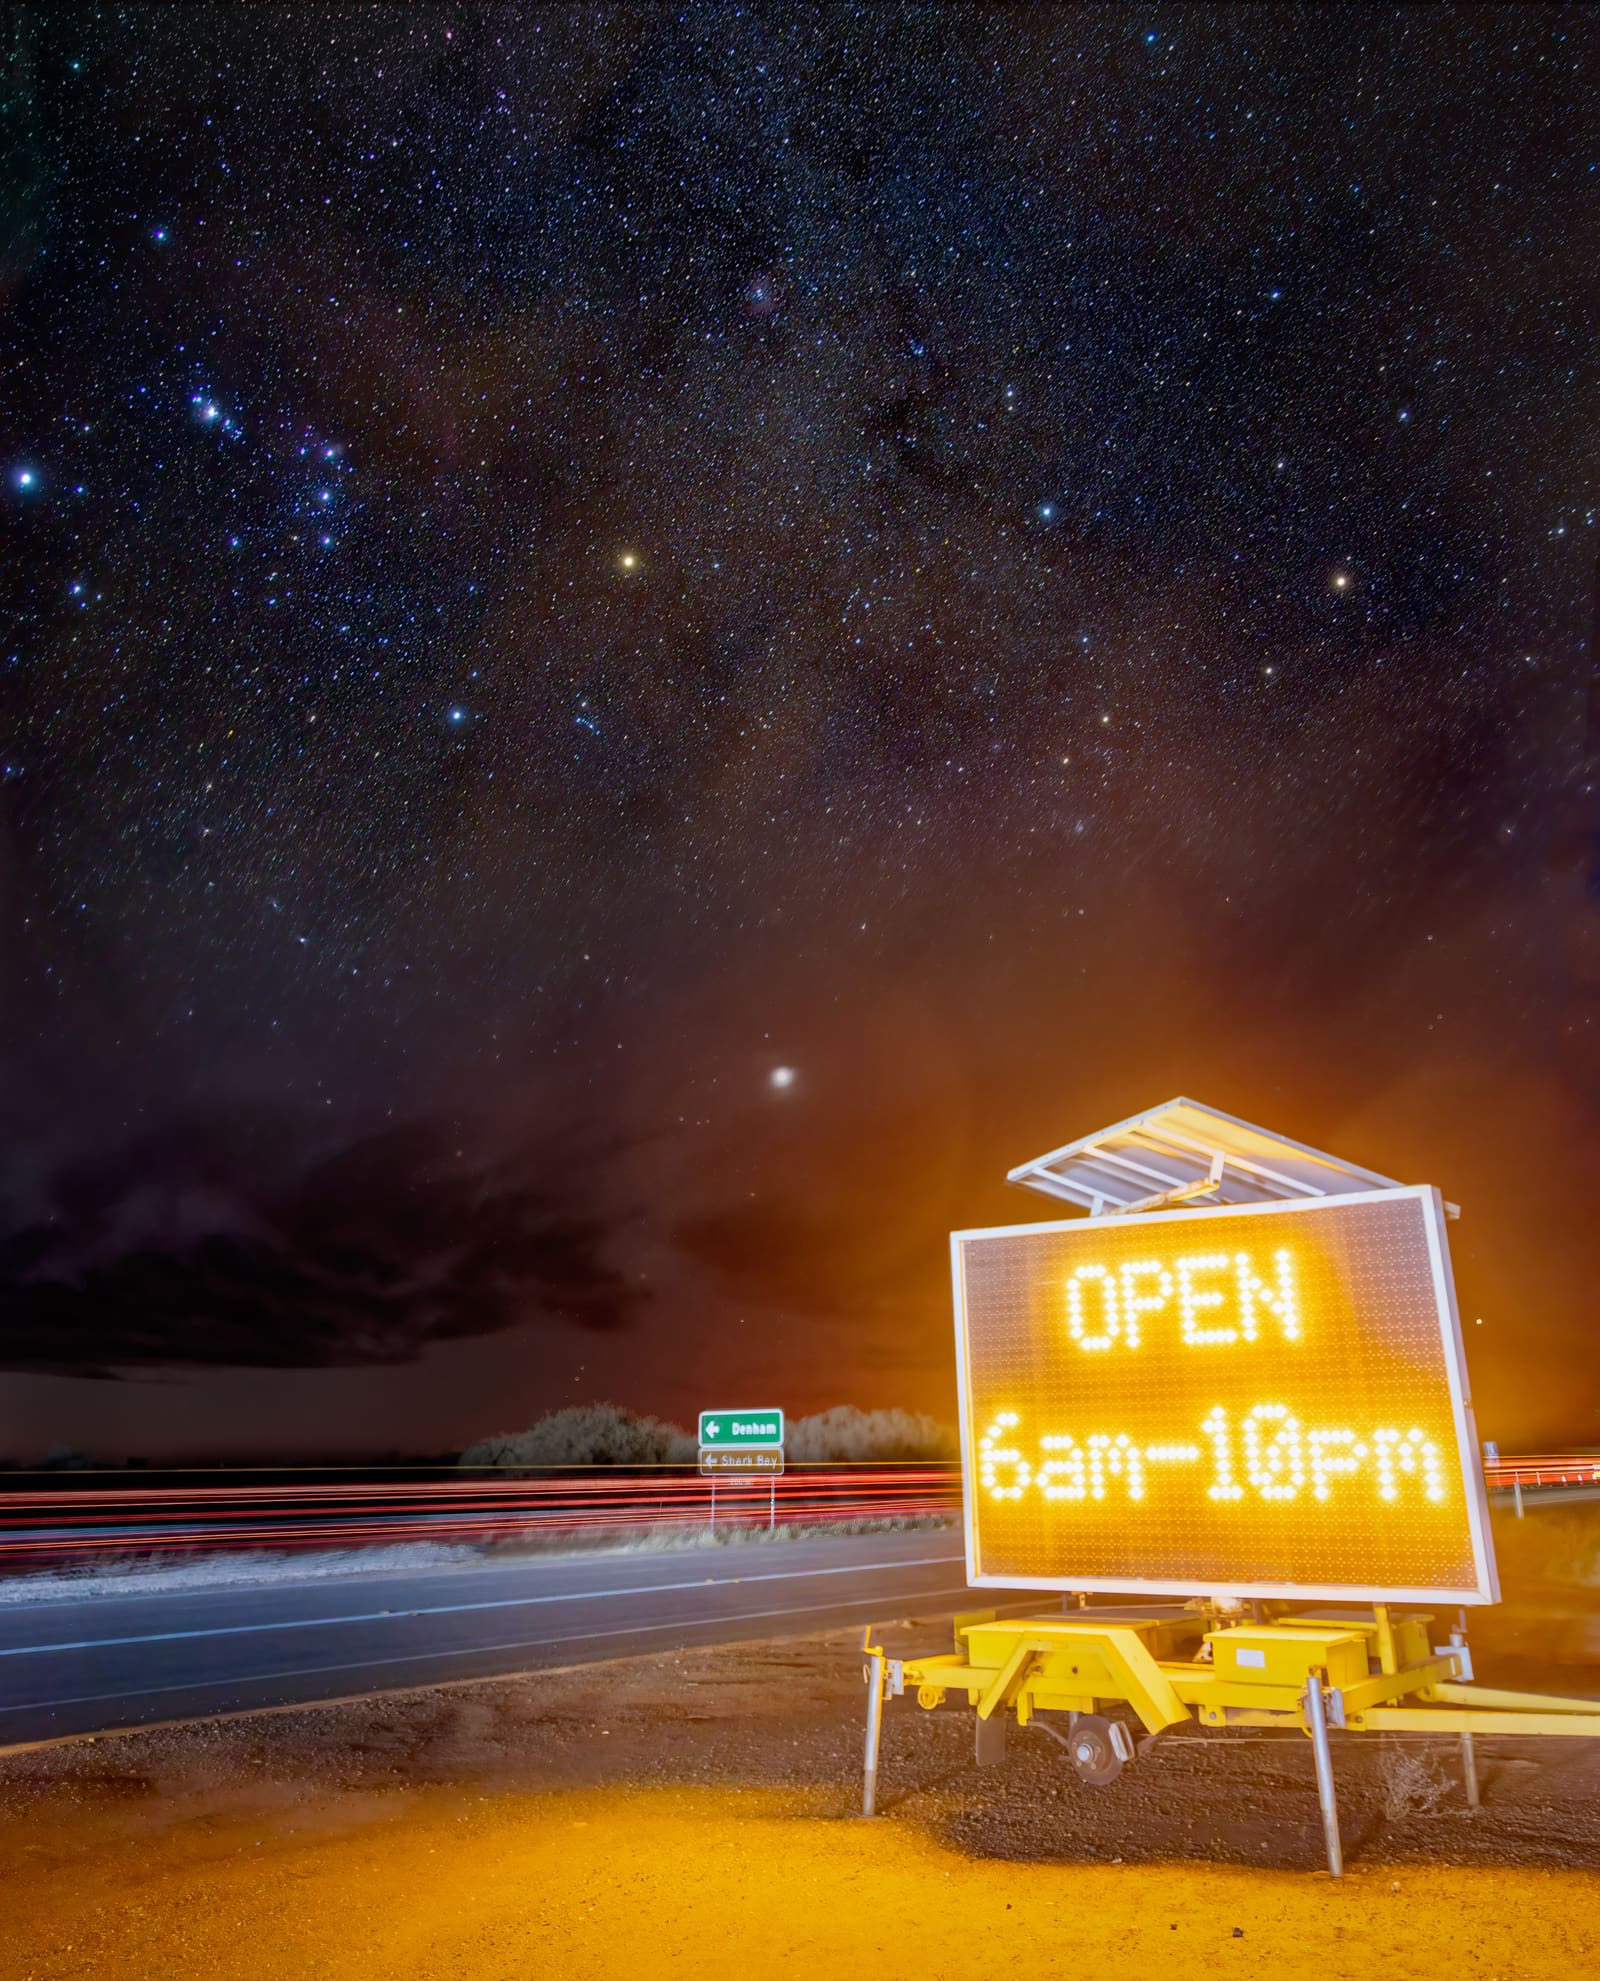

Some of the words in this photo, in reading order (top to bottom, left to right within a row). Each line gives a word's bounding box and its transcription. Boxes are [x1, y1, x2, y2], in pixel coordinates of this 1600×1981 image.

[1069, 1250, 1300, 1350] OPEN
[732, 1422, 776, 1435] Denham
[722, 1455, 753, 1466] Shark
[757, 1454, 777, 1469] Bay
